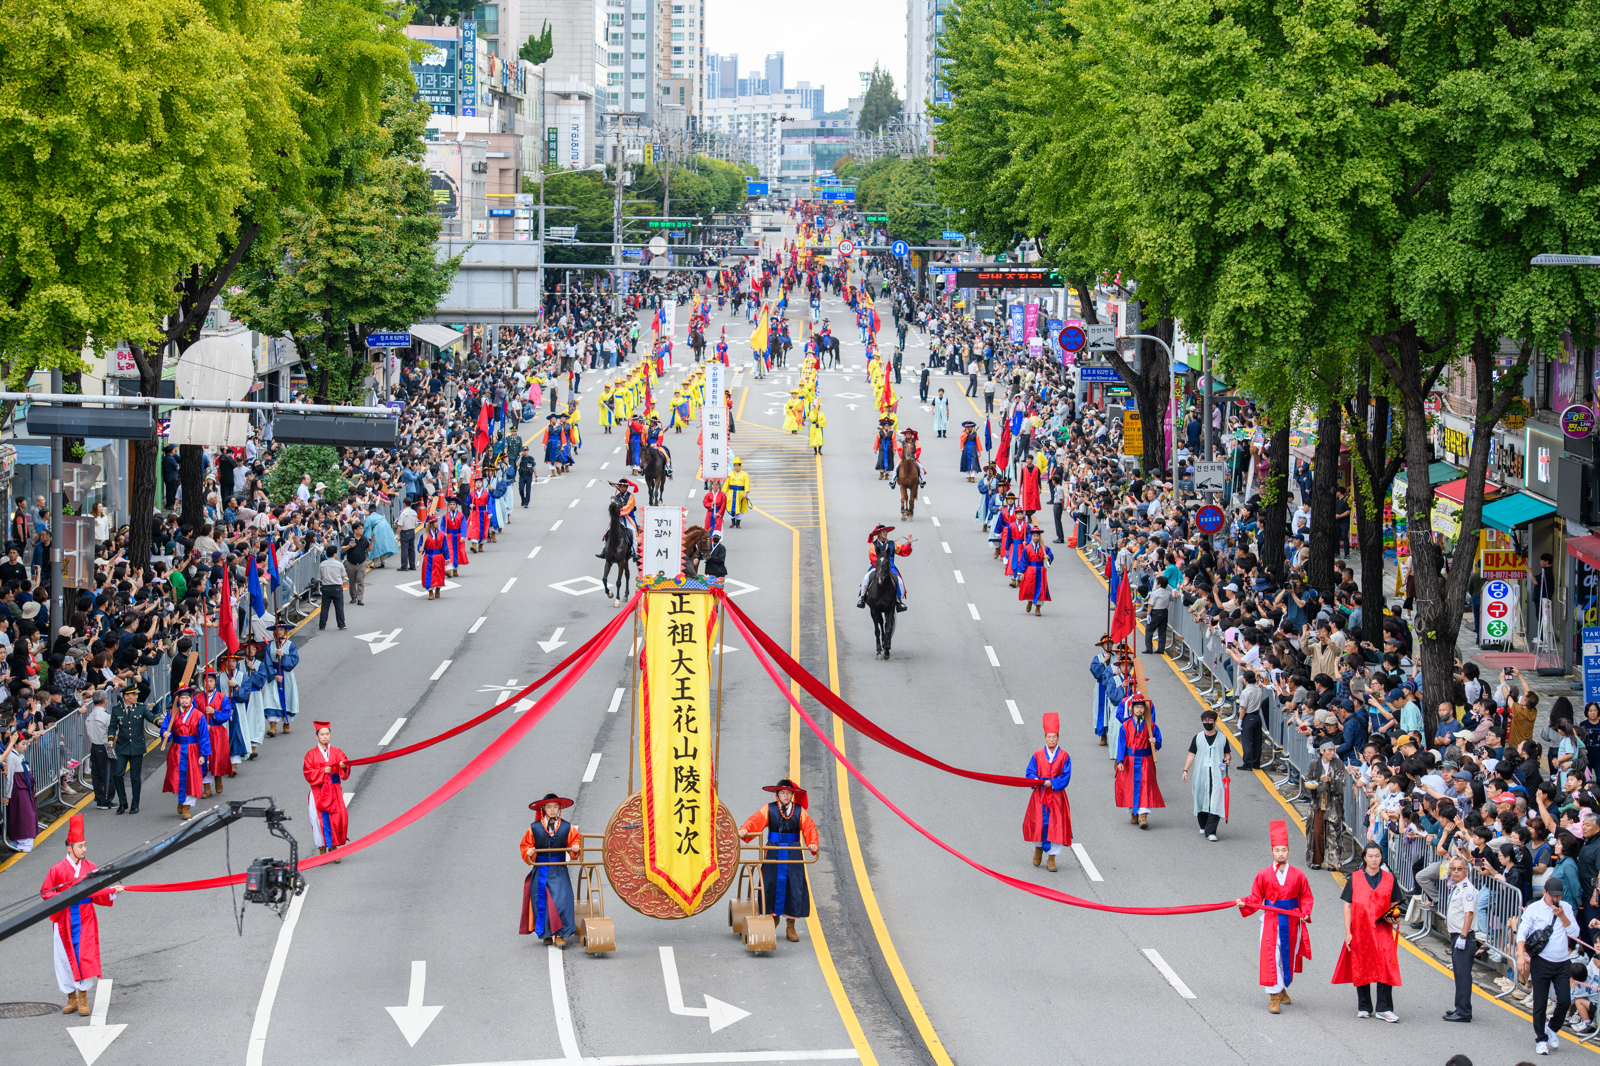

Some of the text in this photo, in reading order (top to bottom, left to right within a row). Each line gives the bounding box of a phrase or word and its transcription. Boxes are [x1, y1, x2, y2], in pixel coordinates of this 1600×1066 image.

[441, 75, 454, 88] 3F
[571, 124, 579, 160] 국민연금
[1568, 424, 1588, 432] 찐이야
[654, 518, 671, 527] 경기
[654, 530, 672, 538] 감사
[1490, 583, 1506, 636] 당구장
[667, 593, 700, 855] 正祖大王花山陵行次
